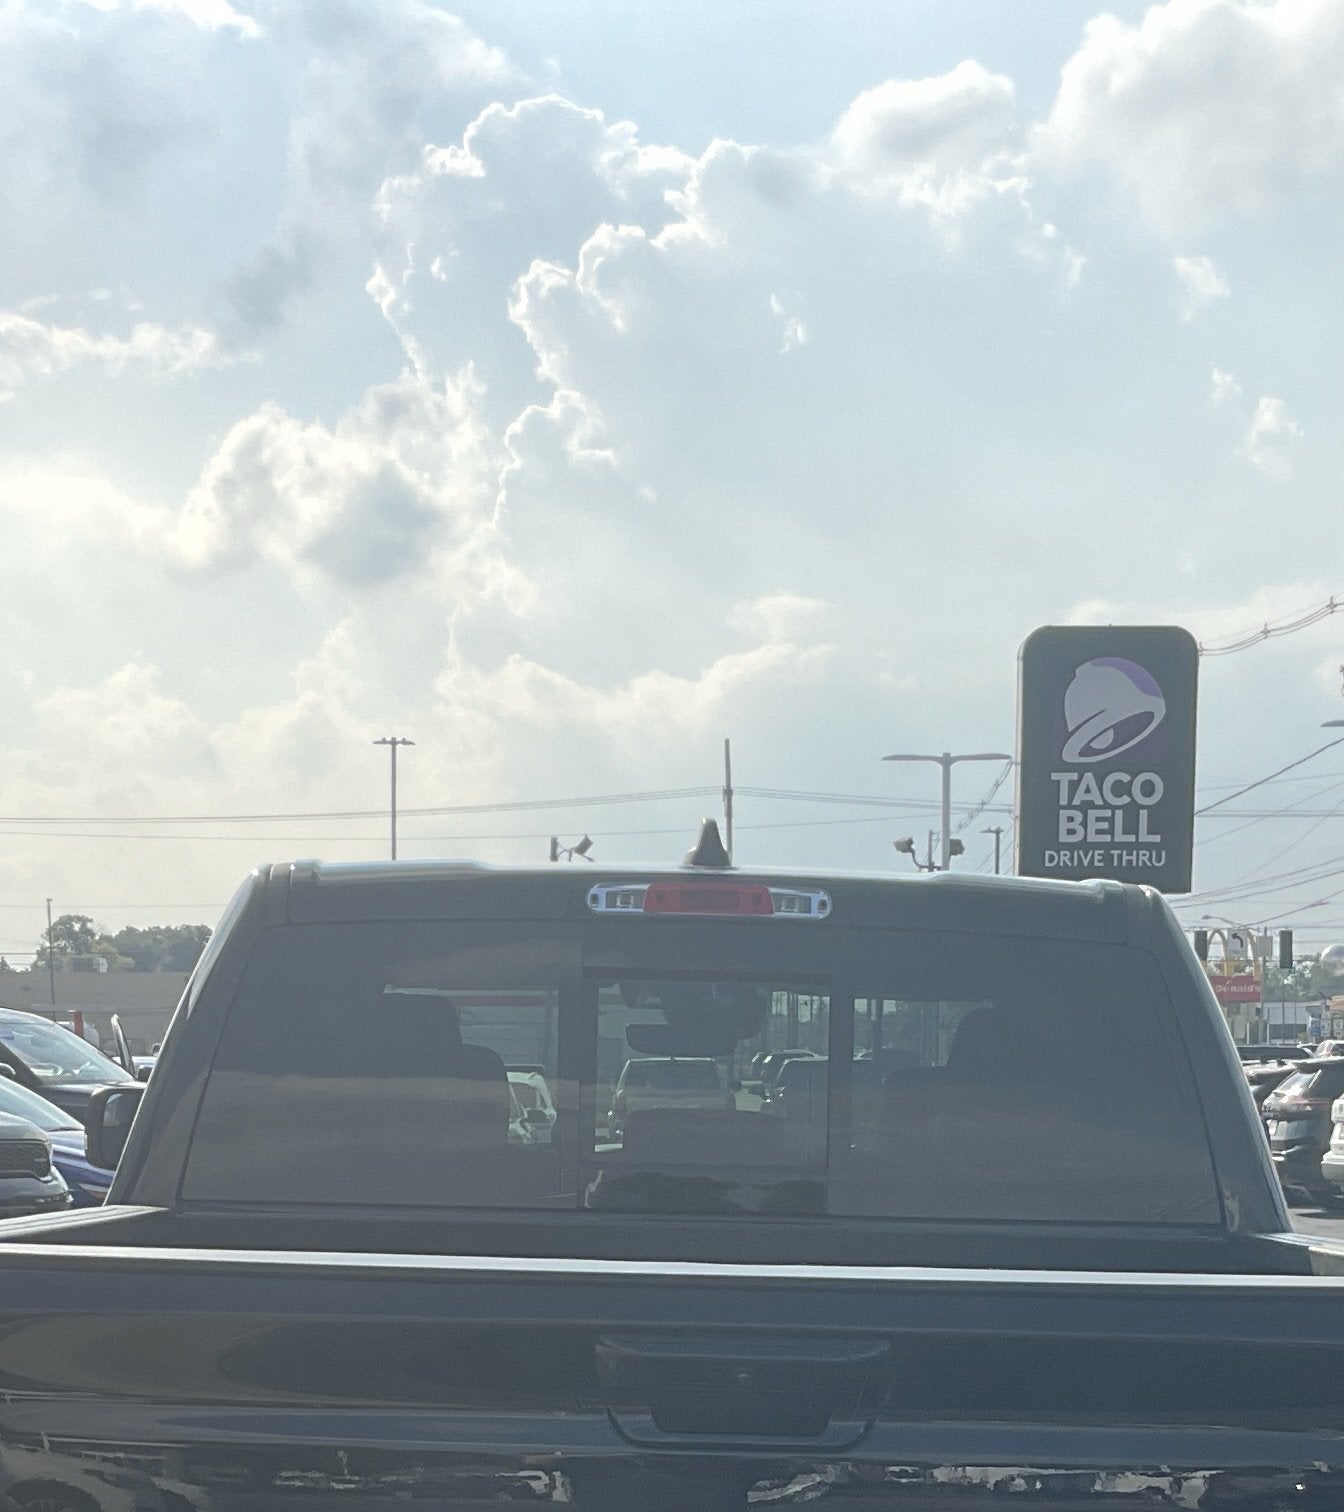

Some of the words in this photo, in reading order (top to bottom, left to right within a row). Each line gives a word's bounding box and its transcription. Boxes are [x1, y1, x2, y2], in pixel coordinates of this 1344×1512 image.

[1050, 771, 1164, 806] TACO
[1058, 809, 1161, 843] BELL
[1044, 850, 1104, 867] DRIVE
[1110, 850, 1166, 867] THRU
[1214, 983, 1262, 993] Donald's
